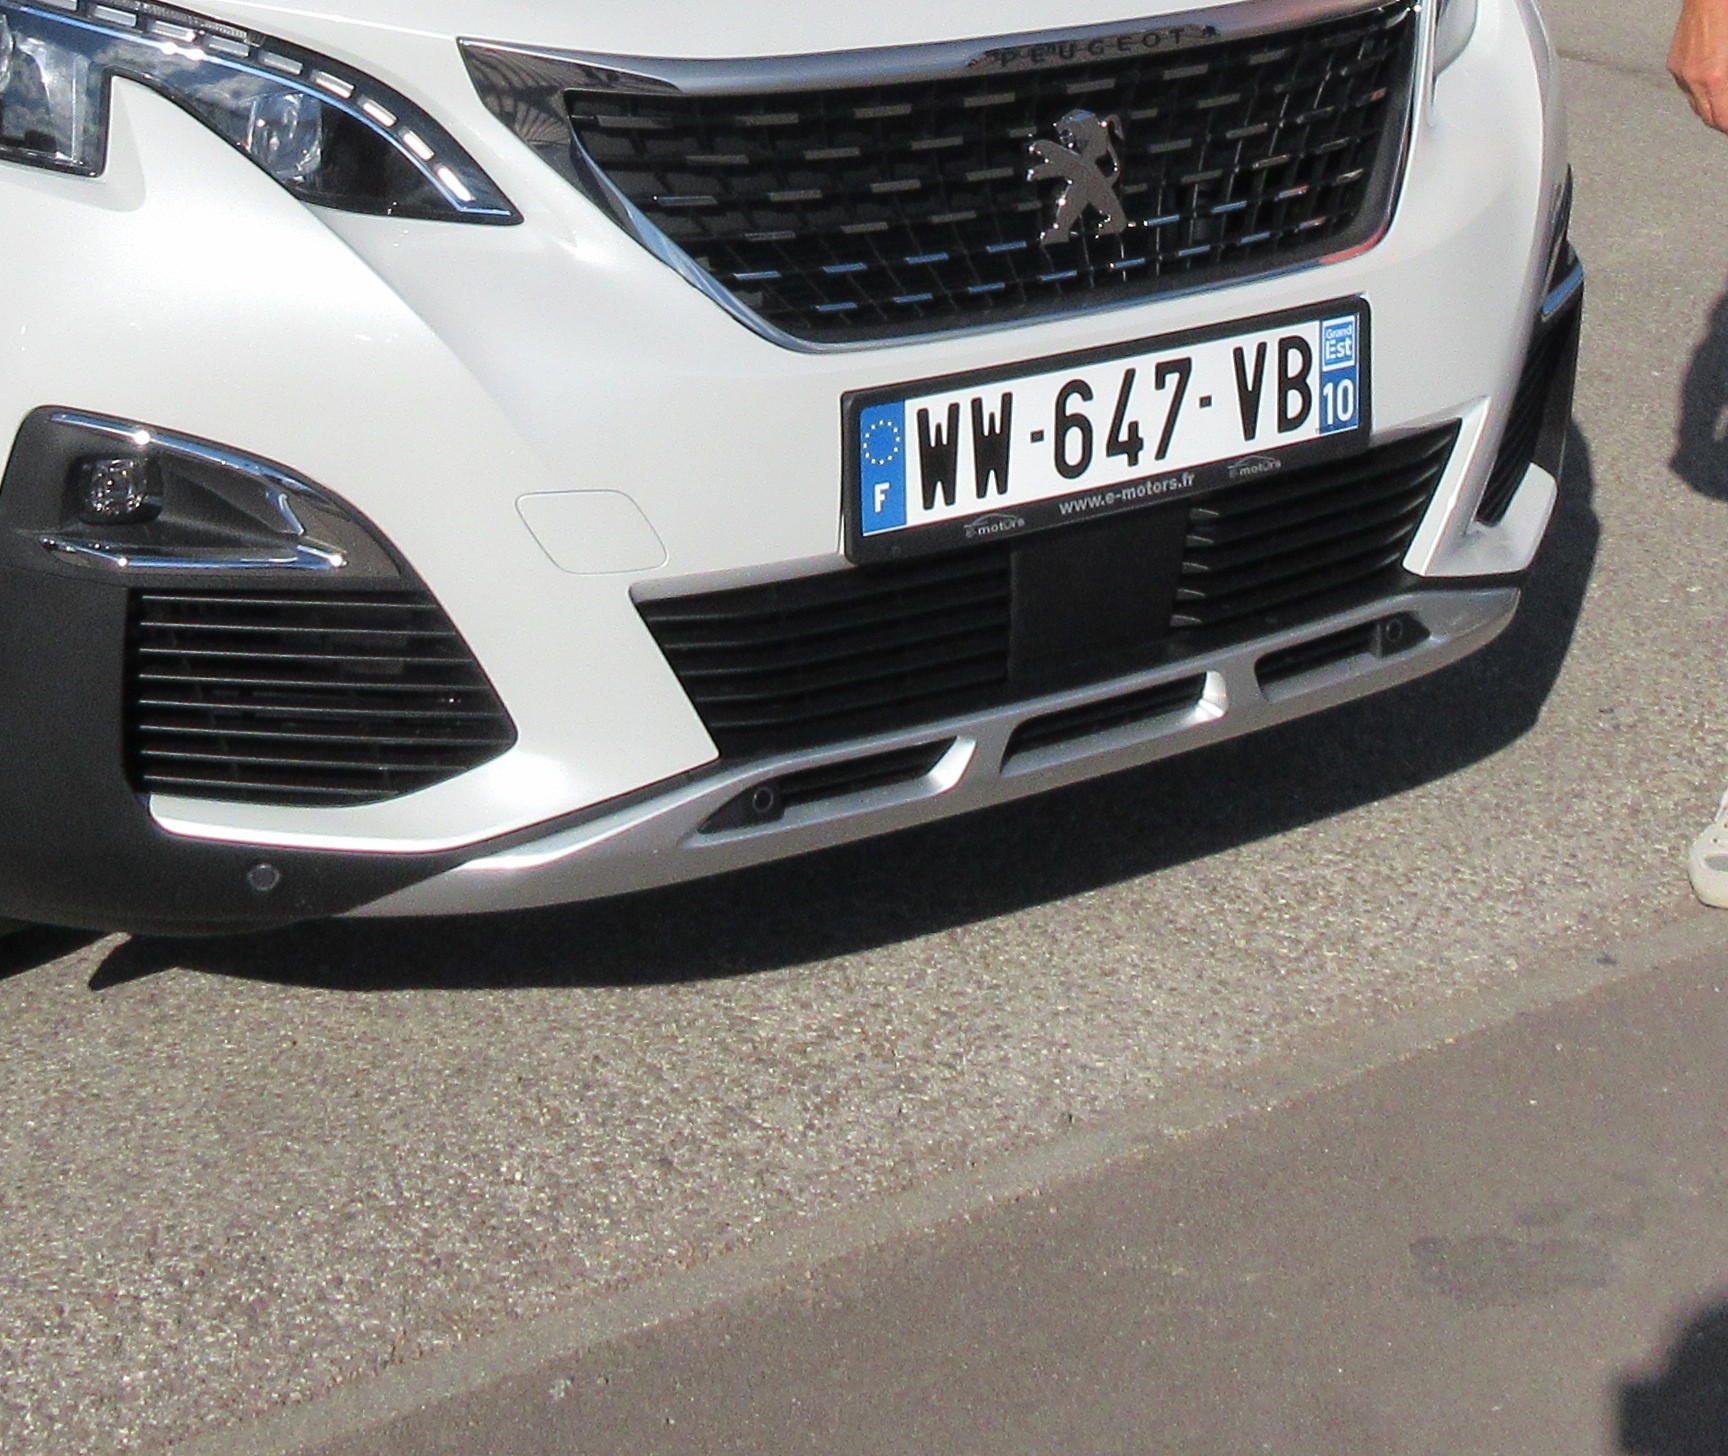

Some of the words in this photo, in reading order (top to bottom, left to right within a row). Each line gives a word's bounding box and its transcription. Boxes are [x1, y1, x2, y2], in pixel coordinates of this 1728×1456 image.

[1000, 27, 1186, 67] PEUGEOT
[1325, 325, 1352, 340] Grand
[1325, 337, 1352, 361] Est
[1323, 378, 1354, 426] 10
[915, 335, 1314, 511] WW-647-VB
[873, 482, 890, 514] F
[1059, 472, 1196, 516] www.e-motors.fr
